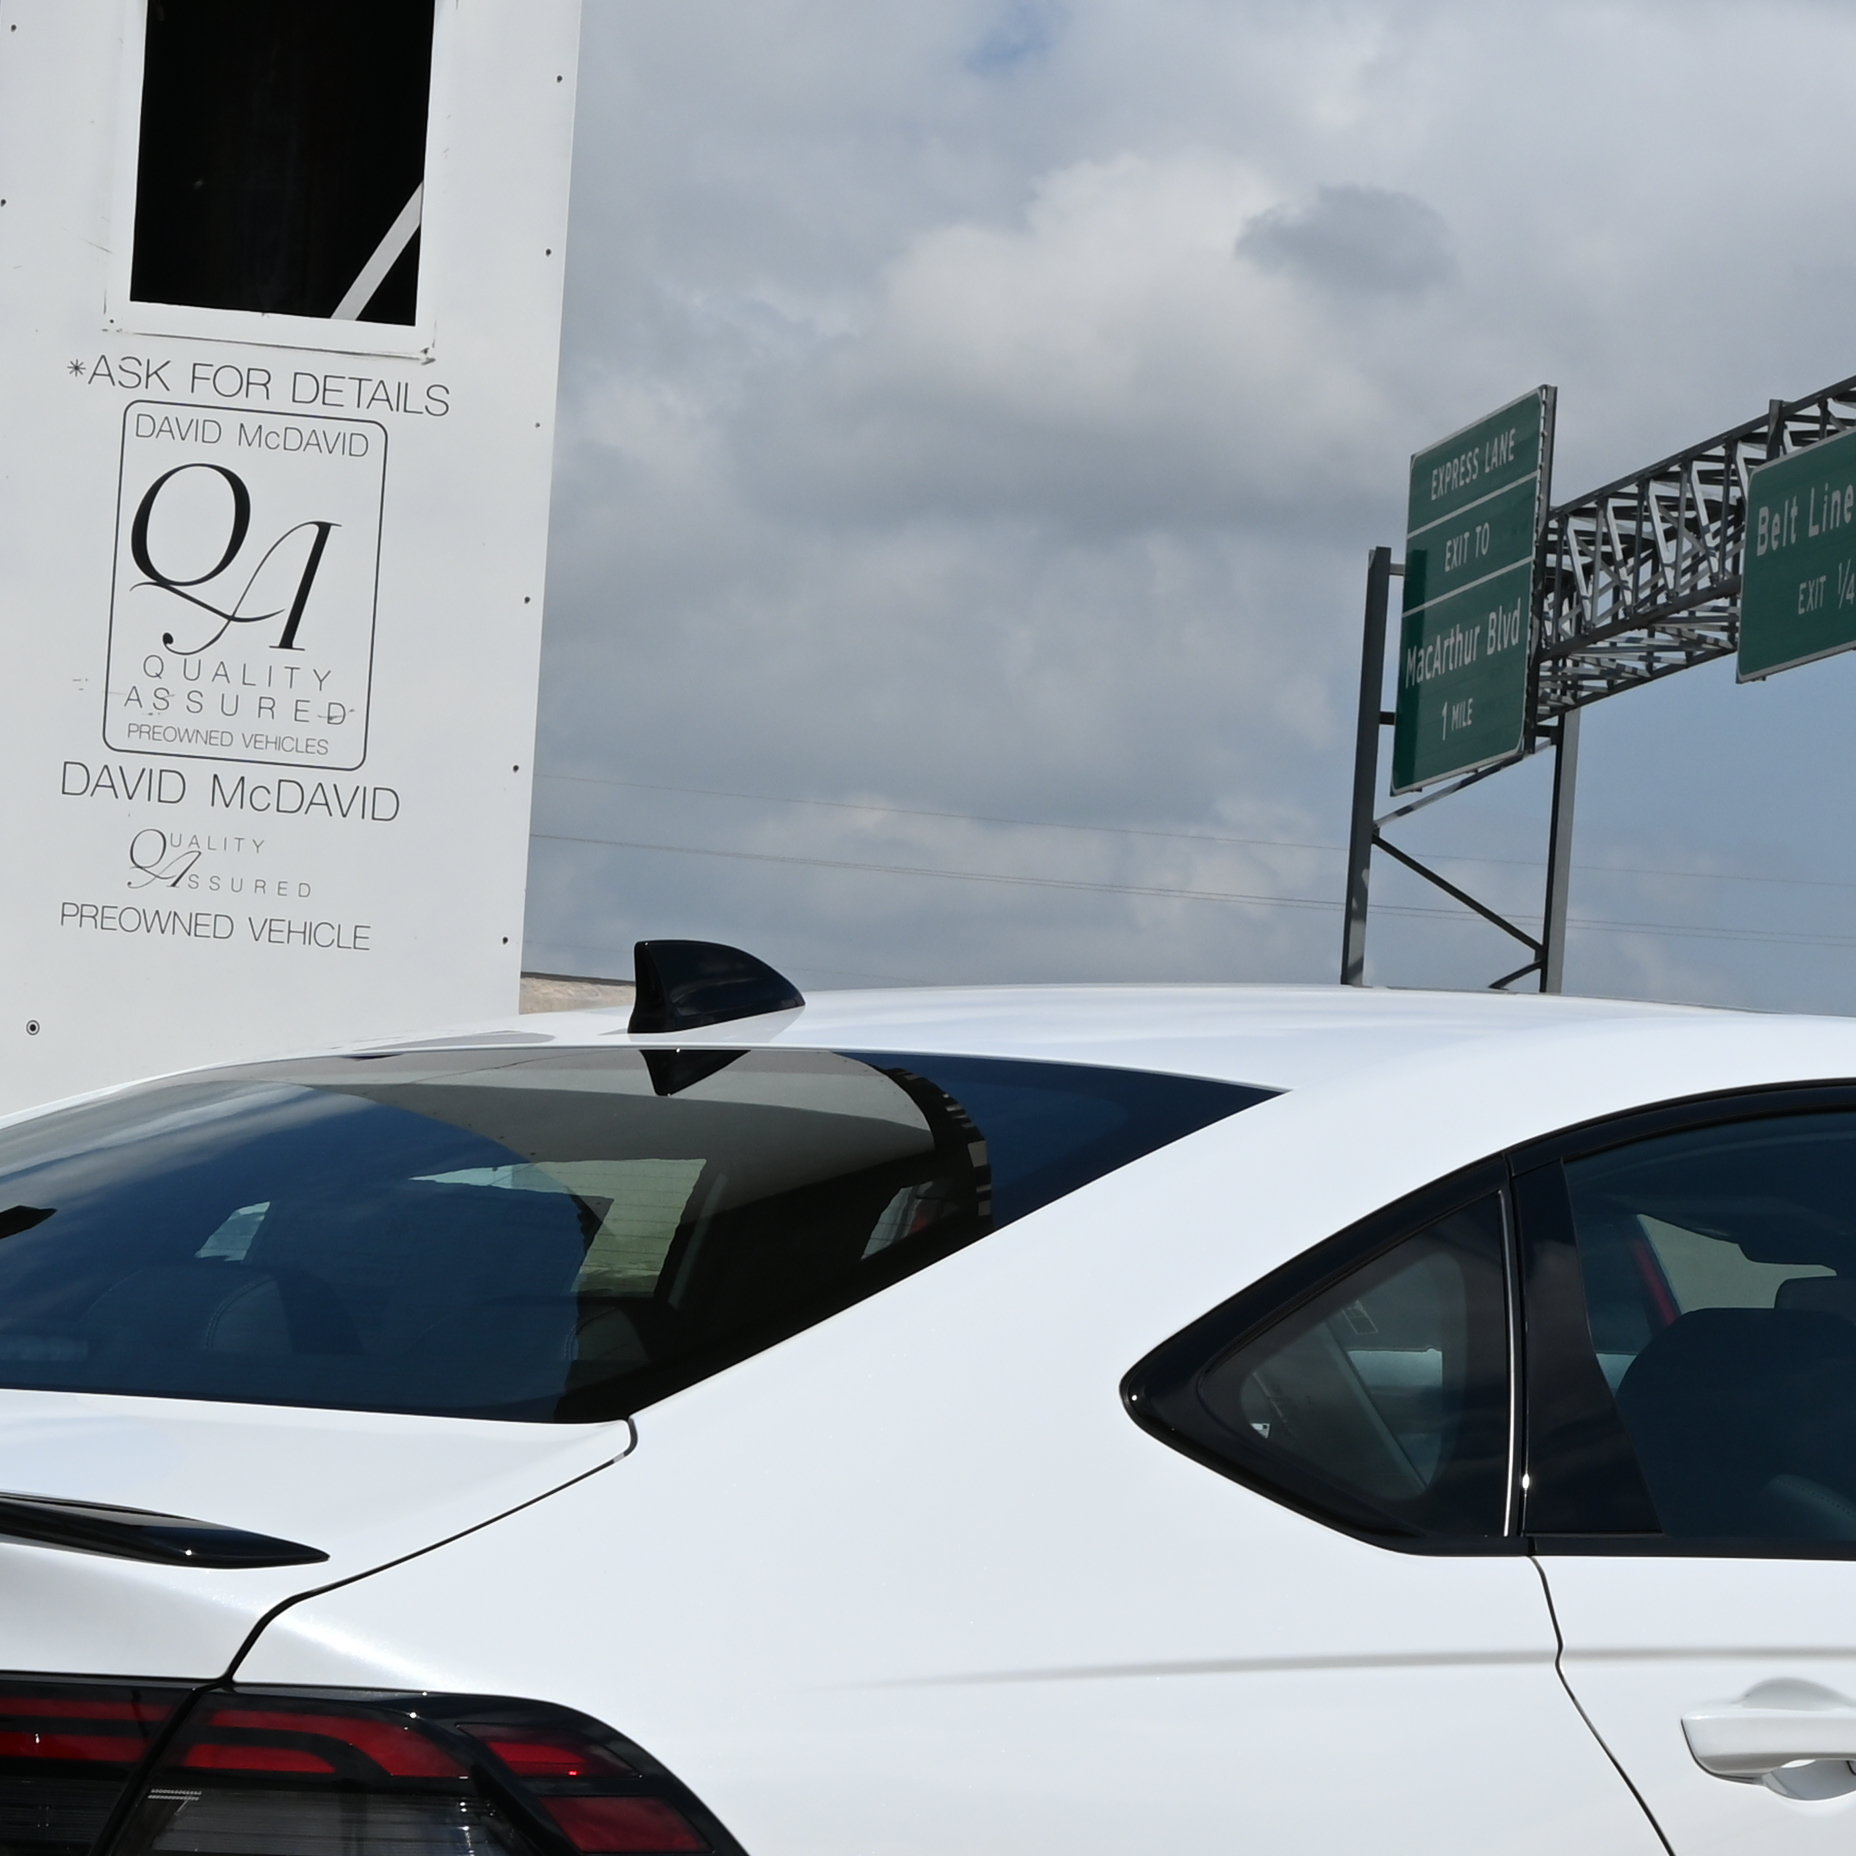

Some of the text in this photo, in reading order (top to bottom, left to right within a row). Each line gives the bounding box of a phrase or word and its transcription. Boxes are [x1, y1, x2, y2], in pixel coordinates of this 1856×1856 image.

[191, 362, 271, 401] FOR
[291, 372, 450, 417] DETAILS
[135, 413, 369, 458] DAVID McDAVID
[1431, 427, 1515, 501] EXPRESS LANE
[1756, 495, 1799, 557] Belt
[1808, 482, 1854, 537] Line
[1445, 521, 1490, 573] EXIT TO
[1798, 574, 1827, 615] EXIT
[1405, 597, 1521, 689] MacArthur Blvd
[143, 654, 332, 692] QUALITY
[124, 686, 347, 726] ASSURED
[1441, 697, 1473, 741] 1 MILE
[127, 724, 329, 756] PREOWNED VEHICLES
[61, 761, 400, 822] DAVID McDAVID
[61, 901, 371, 951] PREOWNED VEHICLE
